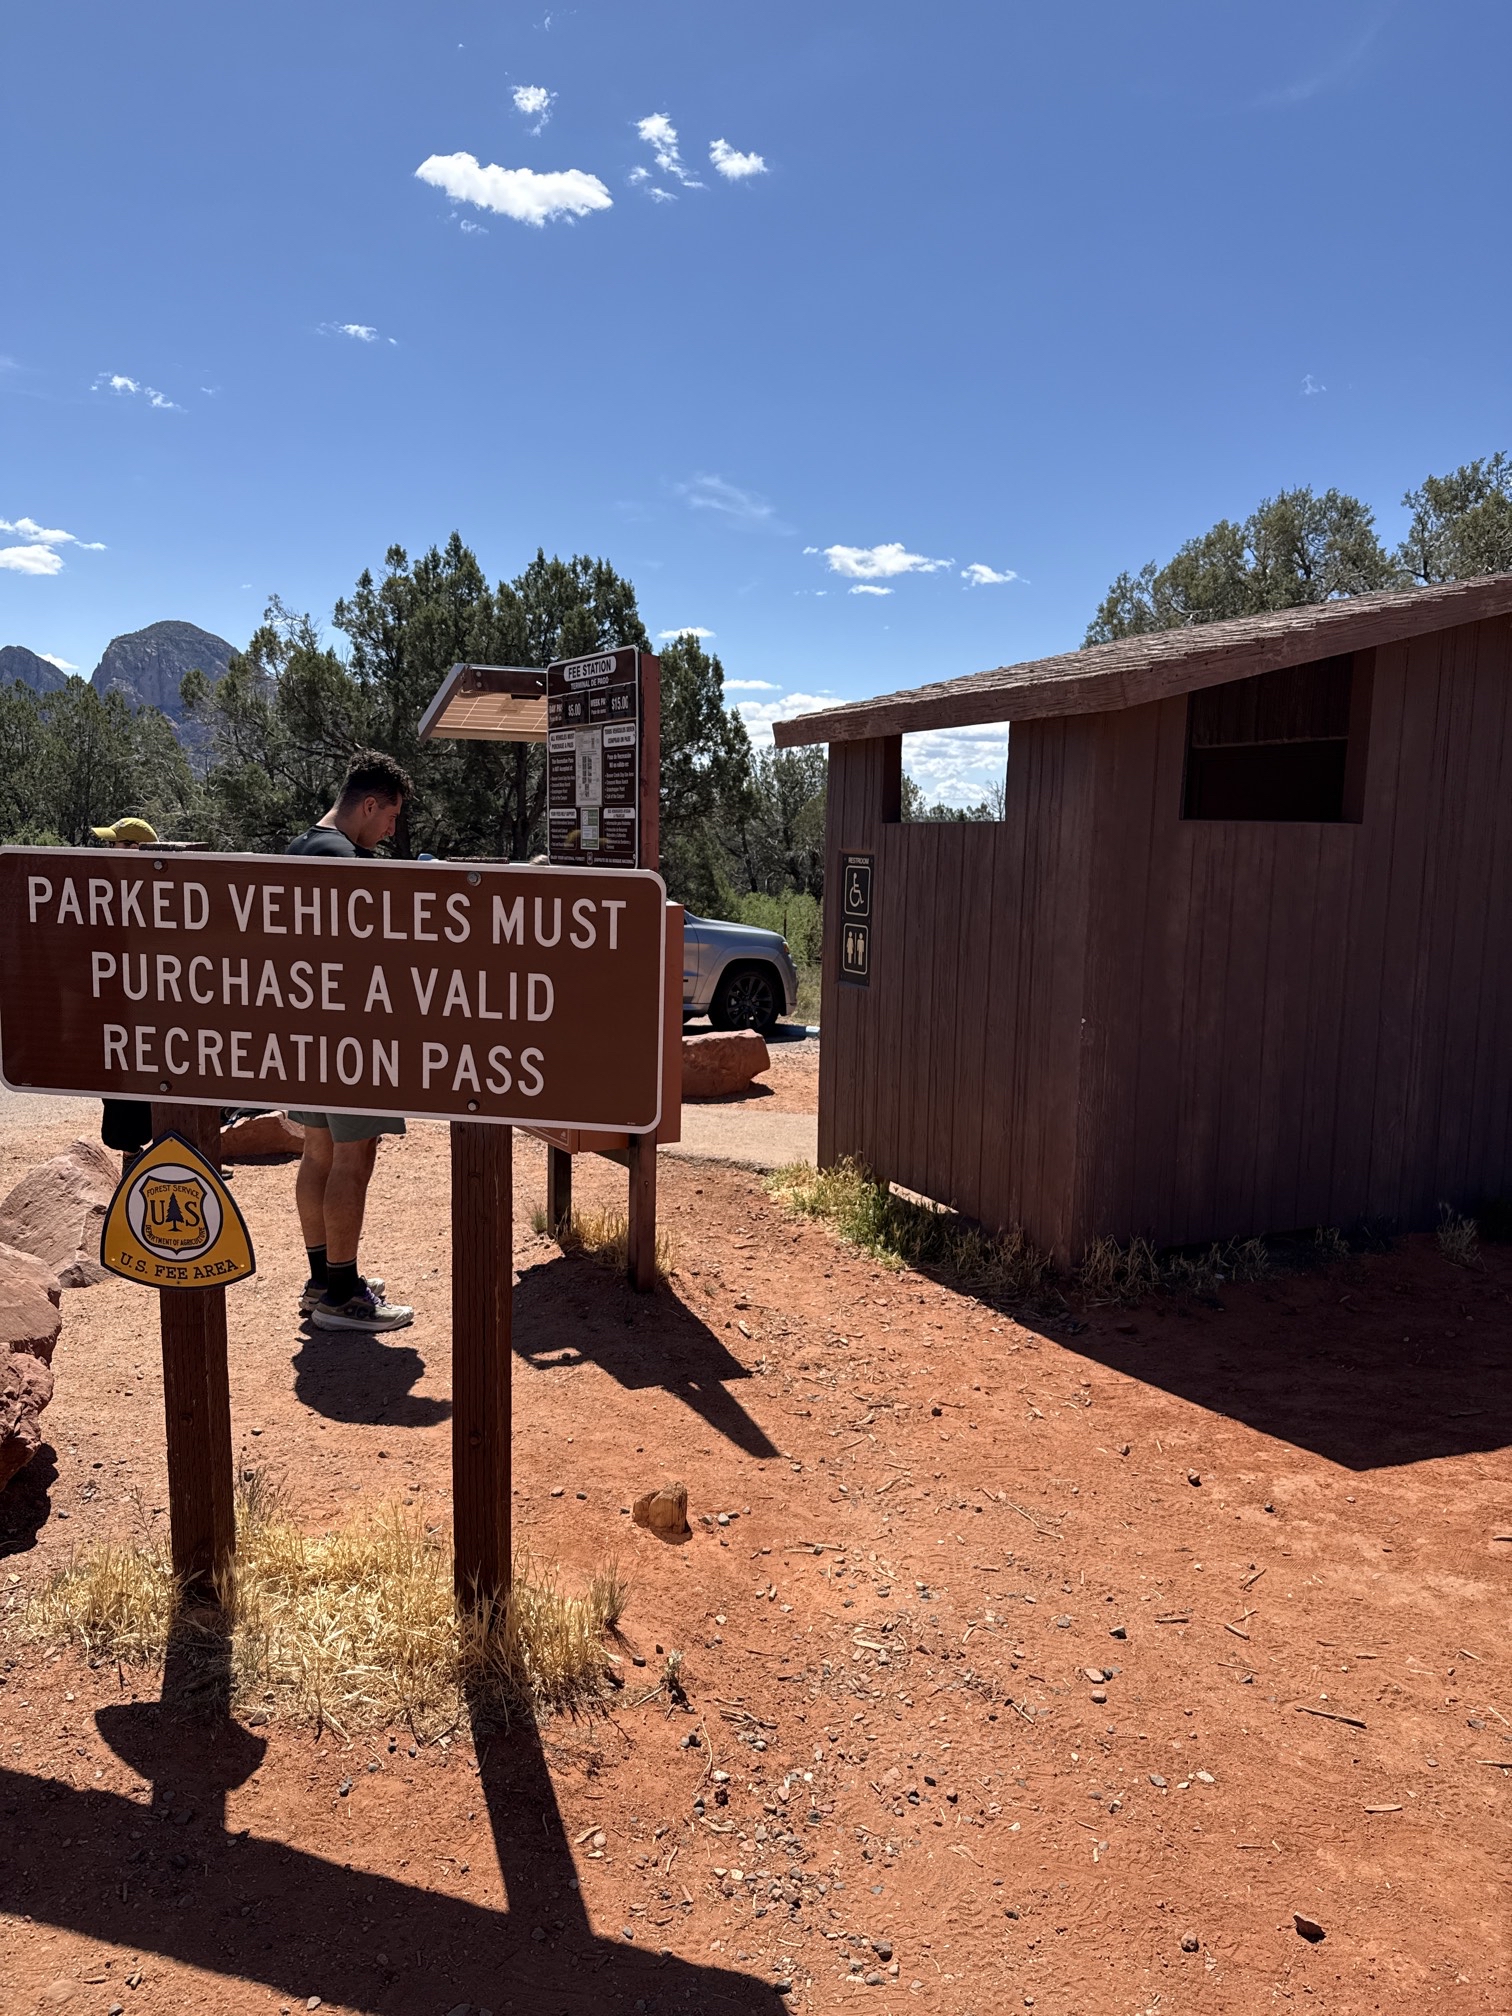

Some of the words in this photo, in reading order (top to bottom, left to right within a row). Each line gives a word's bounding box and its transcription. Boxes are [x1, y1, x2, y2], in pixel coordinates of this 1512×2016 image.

[568, 665, 581, 679] FEE
[582, 659, 612, 676] STATION
[570, 680, 590, 690] TERMINAL
[591, 679, 597, 687] DE
[568, 703, 581, 717] $5.00
[848, 856, 870, 864] RESTROOM
[29, 877, 208, 929] PARKED
[229, 884, 471, 942] VEHICLES
[493, 896, 626, 949] MUST
[92, 952, 345, 1010] PURCHASE
[365, 966, 393, 1013] A
[411, 968, 554, 1021] VALID
[104, 1024, 398, 1086] RECREATION
[423, 1042, 544, 1096] PASS
[146, 1185, 171, 1198] FOREST
[172, 1185, 200, 1199] SERVICE
[145, 1224, 172, 1246] DEPARTMENT
[180, 1226, 206, 1246] AGRICULTURE
[120, 1252, 148, 1274] U.S.
[154, 1264, 188, 1280] FEE
[193, 1259, 239, 1280] AREA
